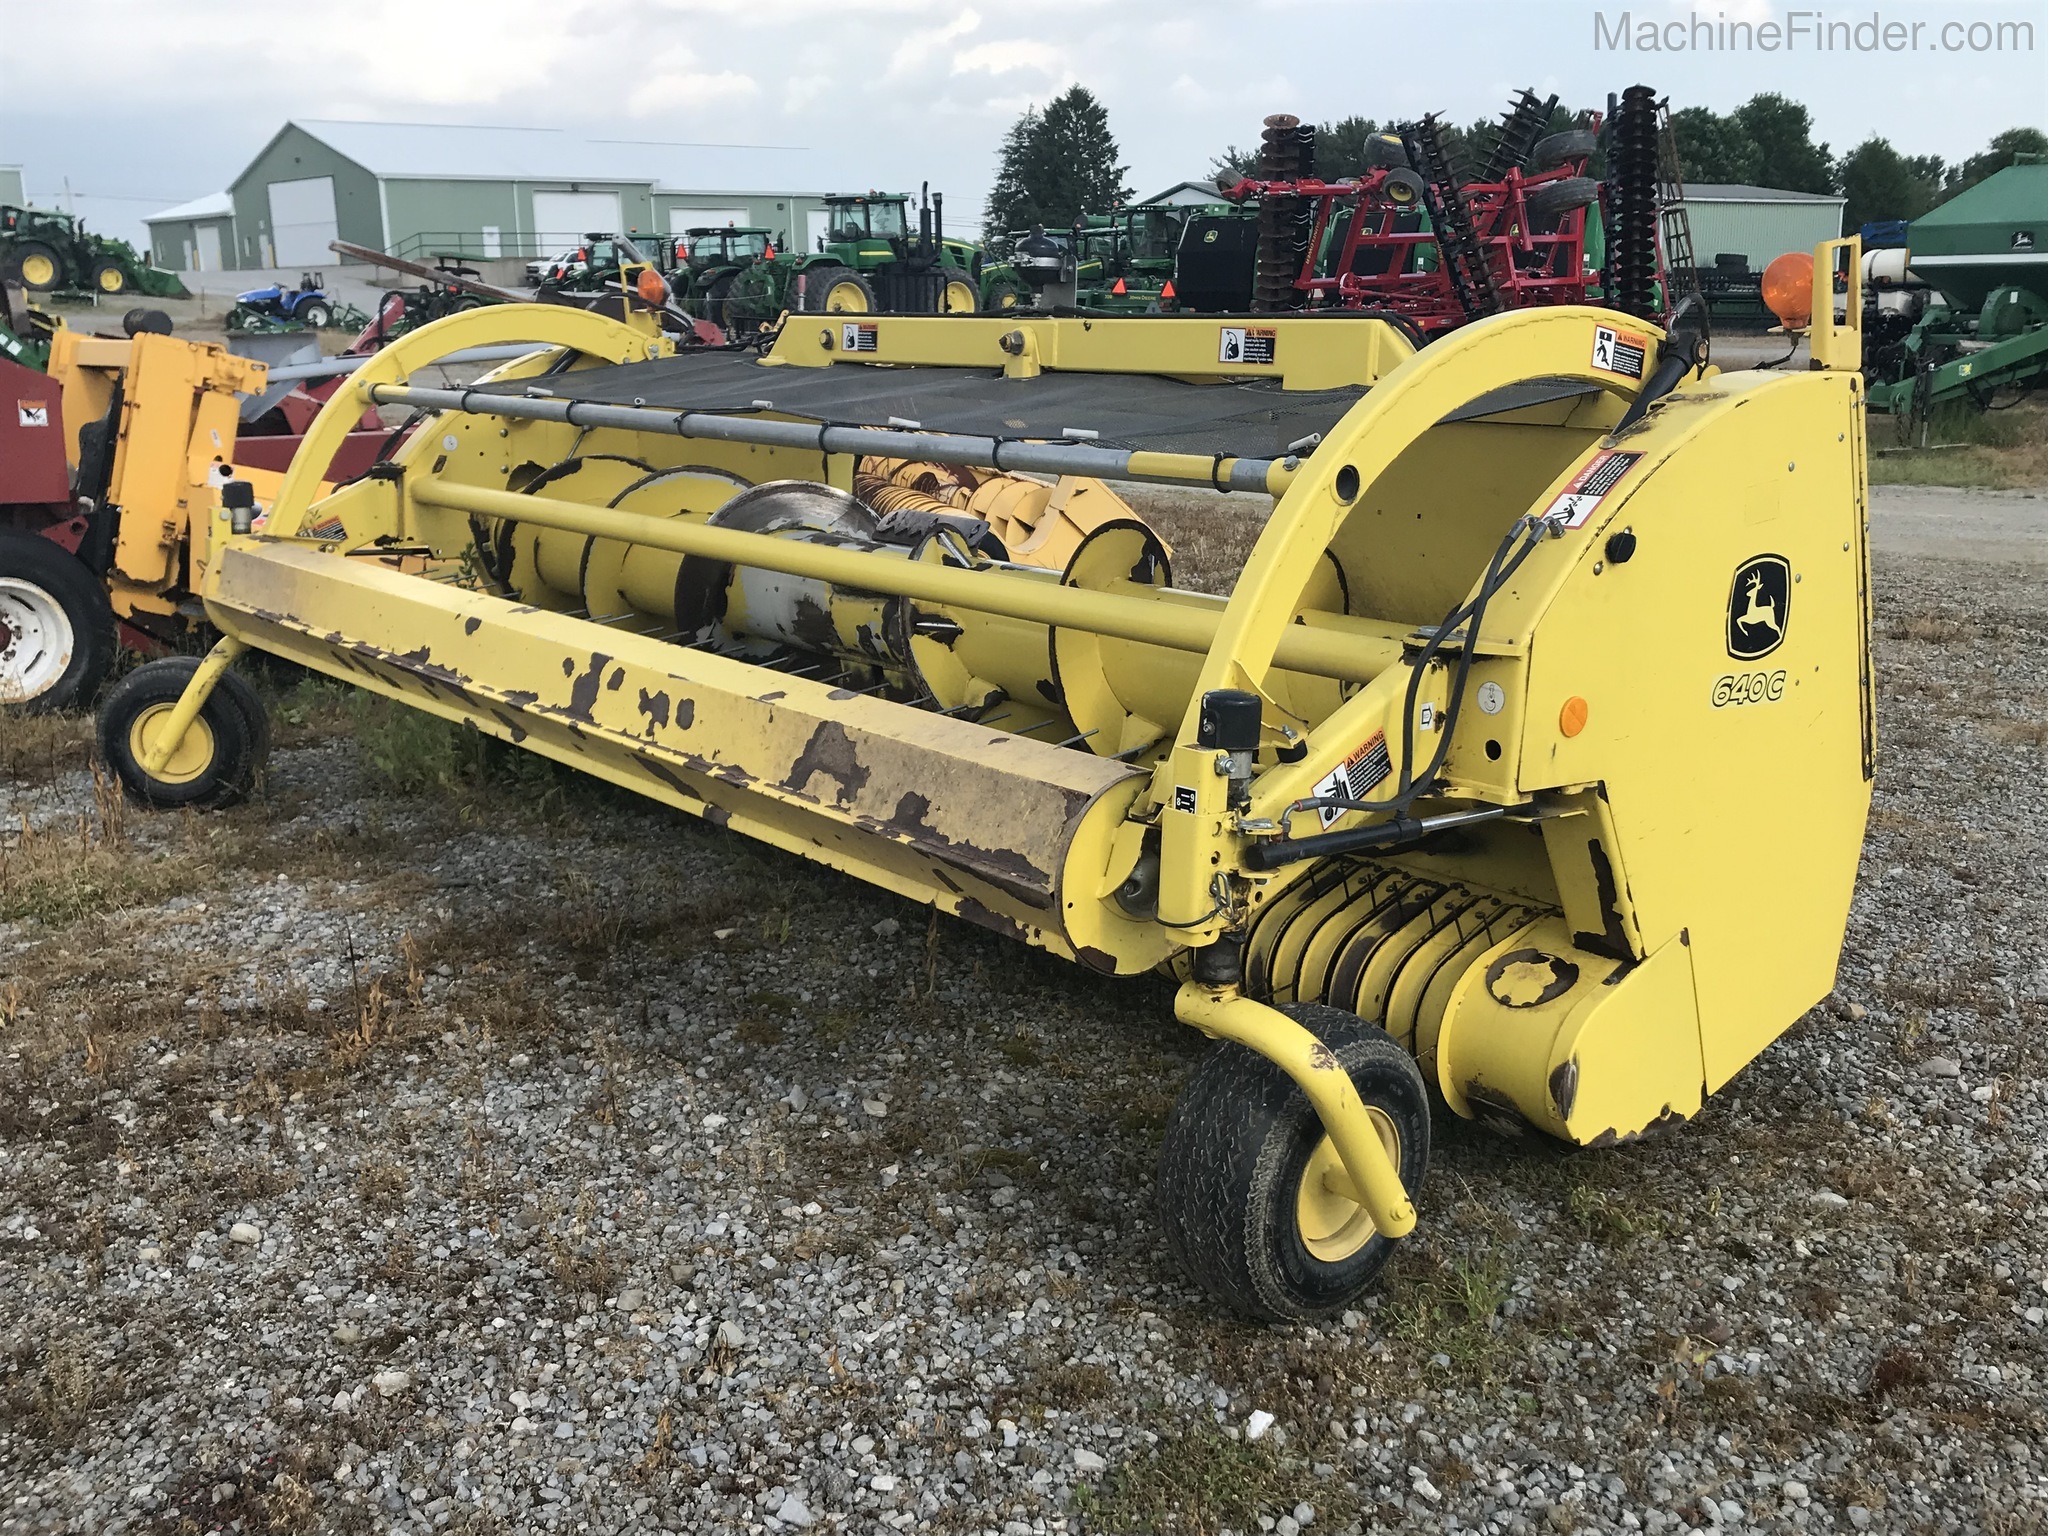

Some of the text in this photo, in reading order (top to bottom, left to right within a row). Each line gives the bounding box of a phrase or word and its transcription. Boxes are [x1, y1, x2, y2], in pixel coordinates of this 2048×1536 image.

[1623, 335, 1645, 348] WARNING
[1580, 455, 1609, 481] DANGER
[1712, 670, 1786, 707] 640C
[1353, 730, 1384, 760] WARNING
[1176, 797, 1181, 806] 8
